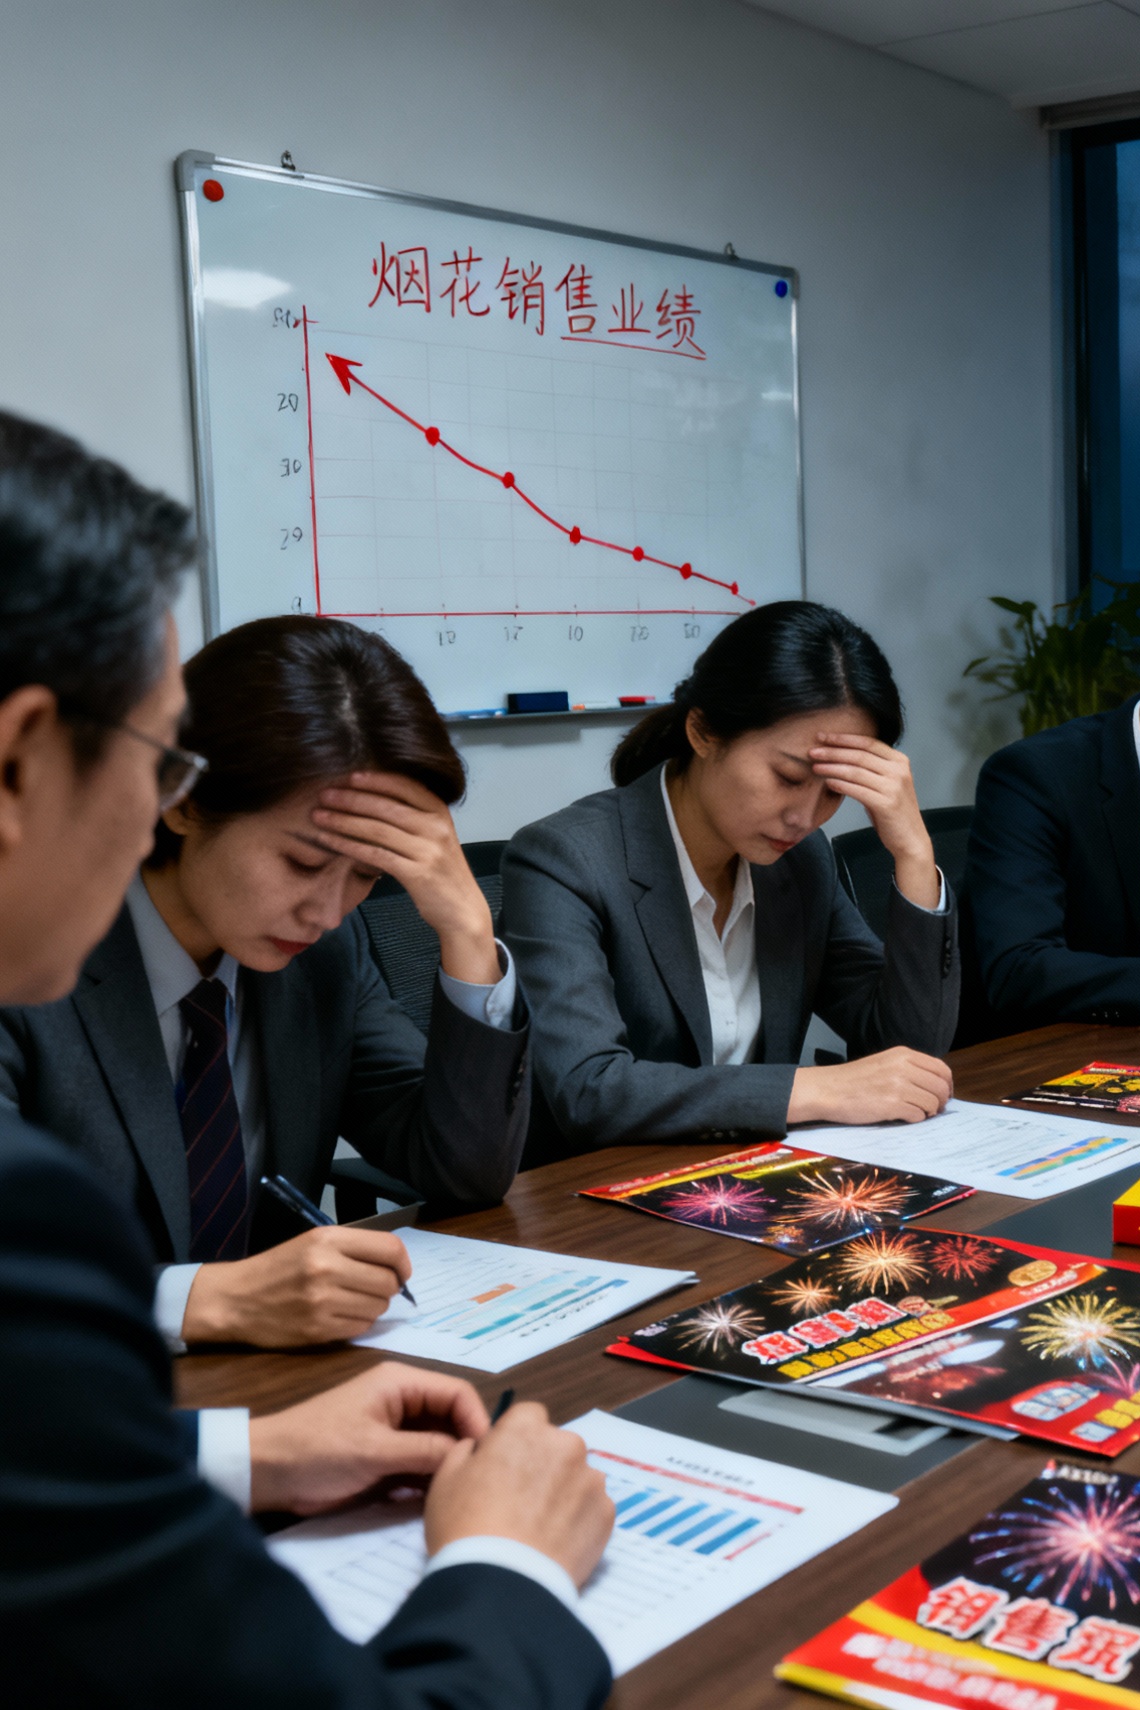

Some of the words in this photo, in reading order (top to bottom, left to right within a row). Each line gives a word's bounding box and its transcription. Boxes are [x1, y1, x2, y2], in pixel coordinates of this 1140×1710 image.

[368, 241, 706, 356] 烟花销售业绩
